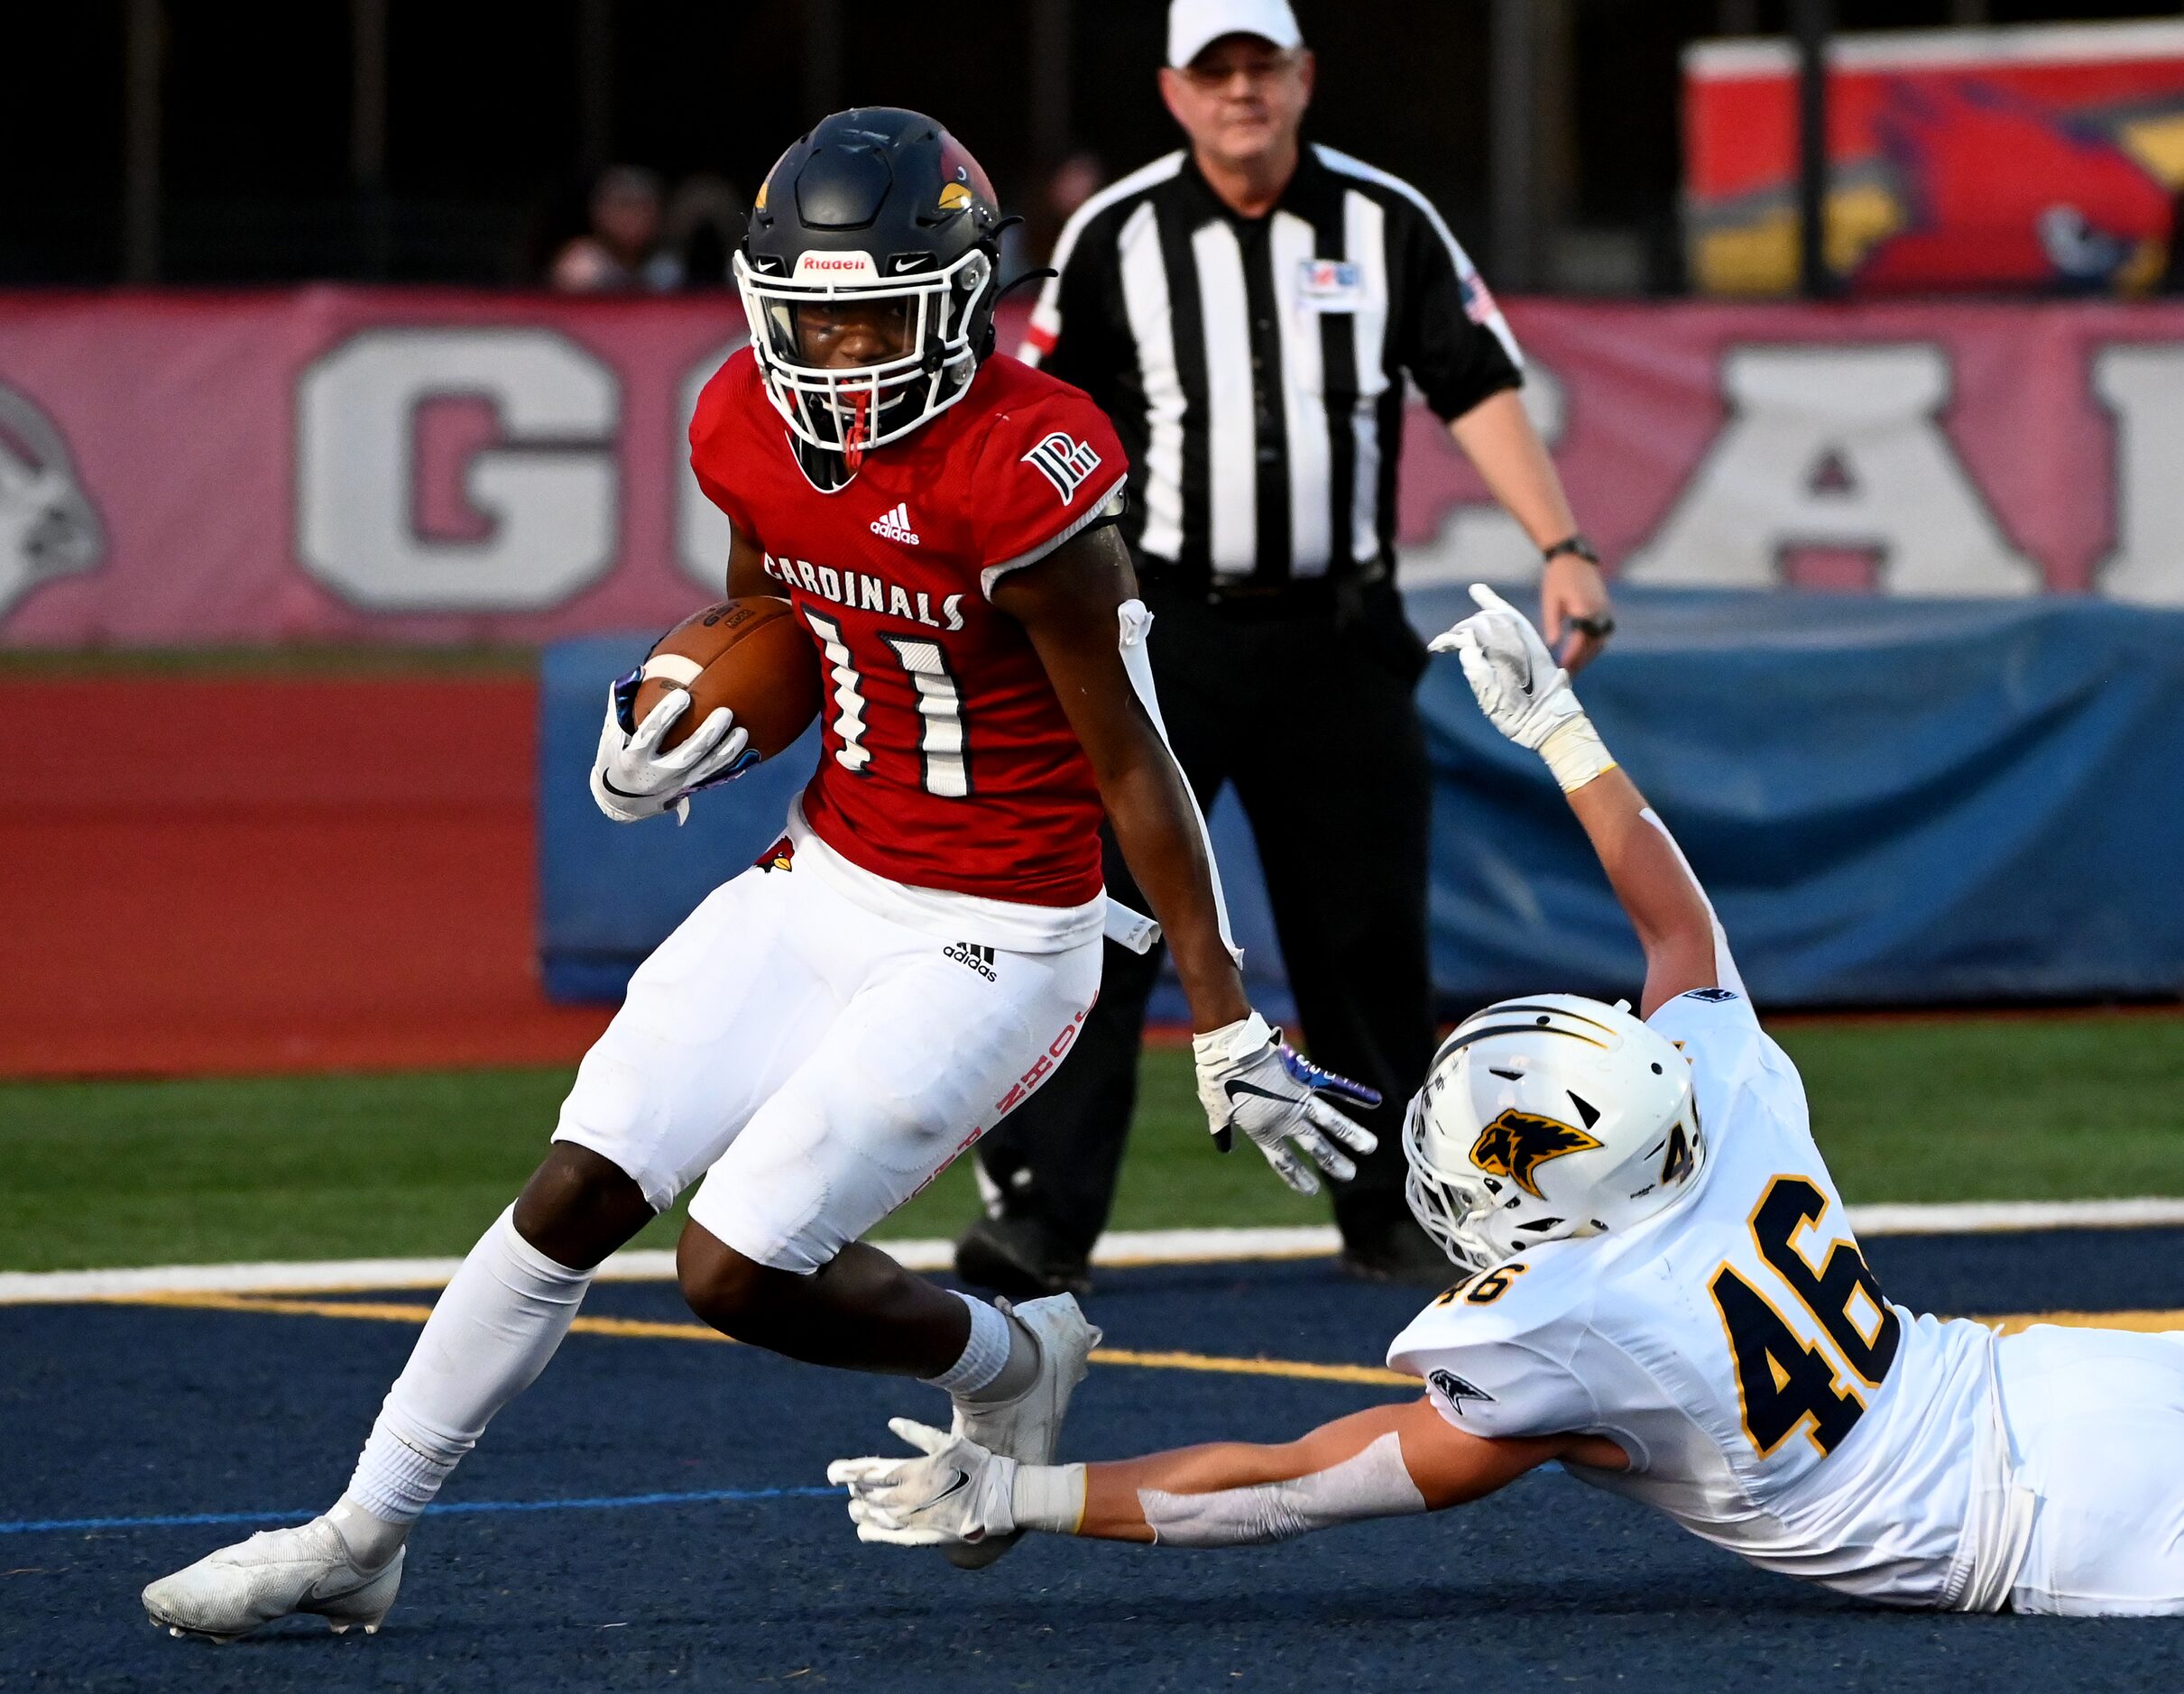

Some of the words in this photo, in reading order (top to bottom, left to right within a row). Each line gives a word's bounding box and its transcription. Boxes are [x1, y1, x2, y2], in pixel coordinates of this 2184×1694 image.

[870, 520, 920, 546] adidas
[763, 551, 966, 631] CARDINALS
[800, 602, 977, 798] 11
[942, 945, 998, 983] adidas
[1706, 1173, 1902, 1463] 46
